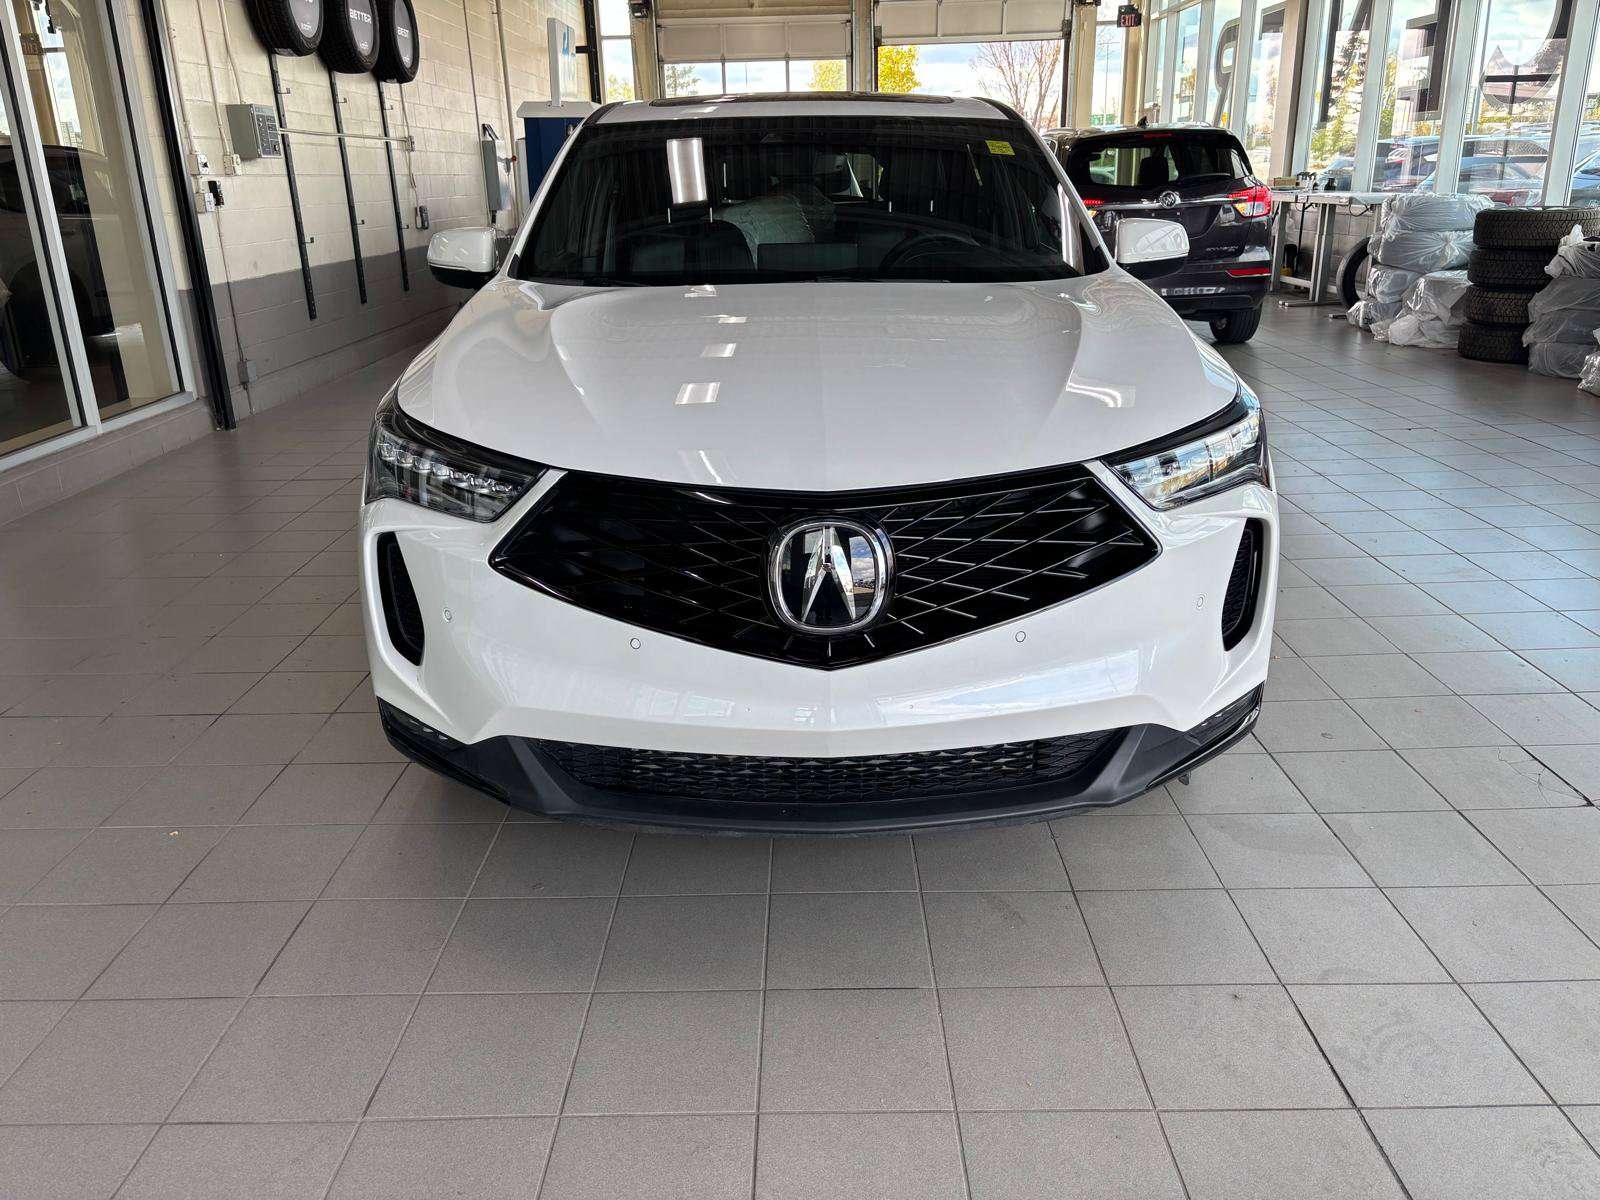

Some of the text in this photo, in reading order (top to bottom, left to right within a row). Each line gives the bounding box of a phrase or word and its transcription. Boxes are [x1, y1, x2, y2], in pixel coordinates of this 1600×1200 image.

[349, 8, 372, 24] BETTER
[1120, 14, 1136, 26] EXIT
[397, 26, 409, 38] BEST
